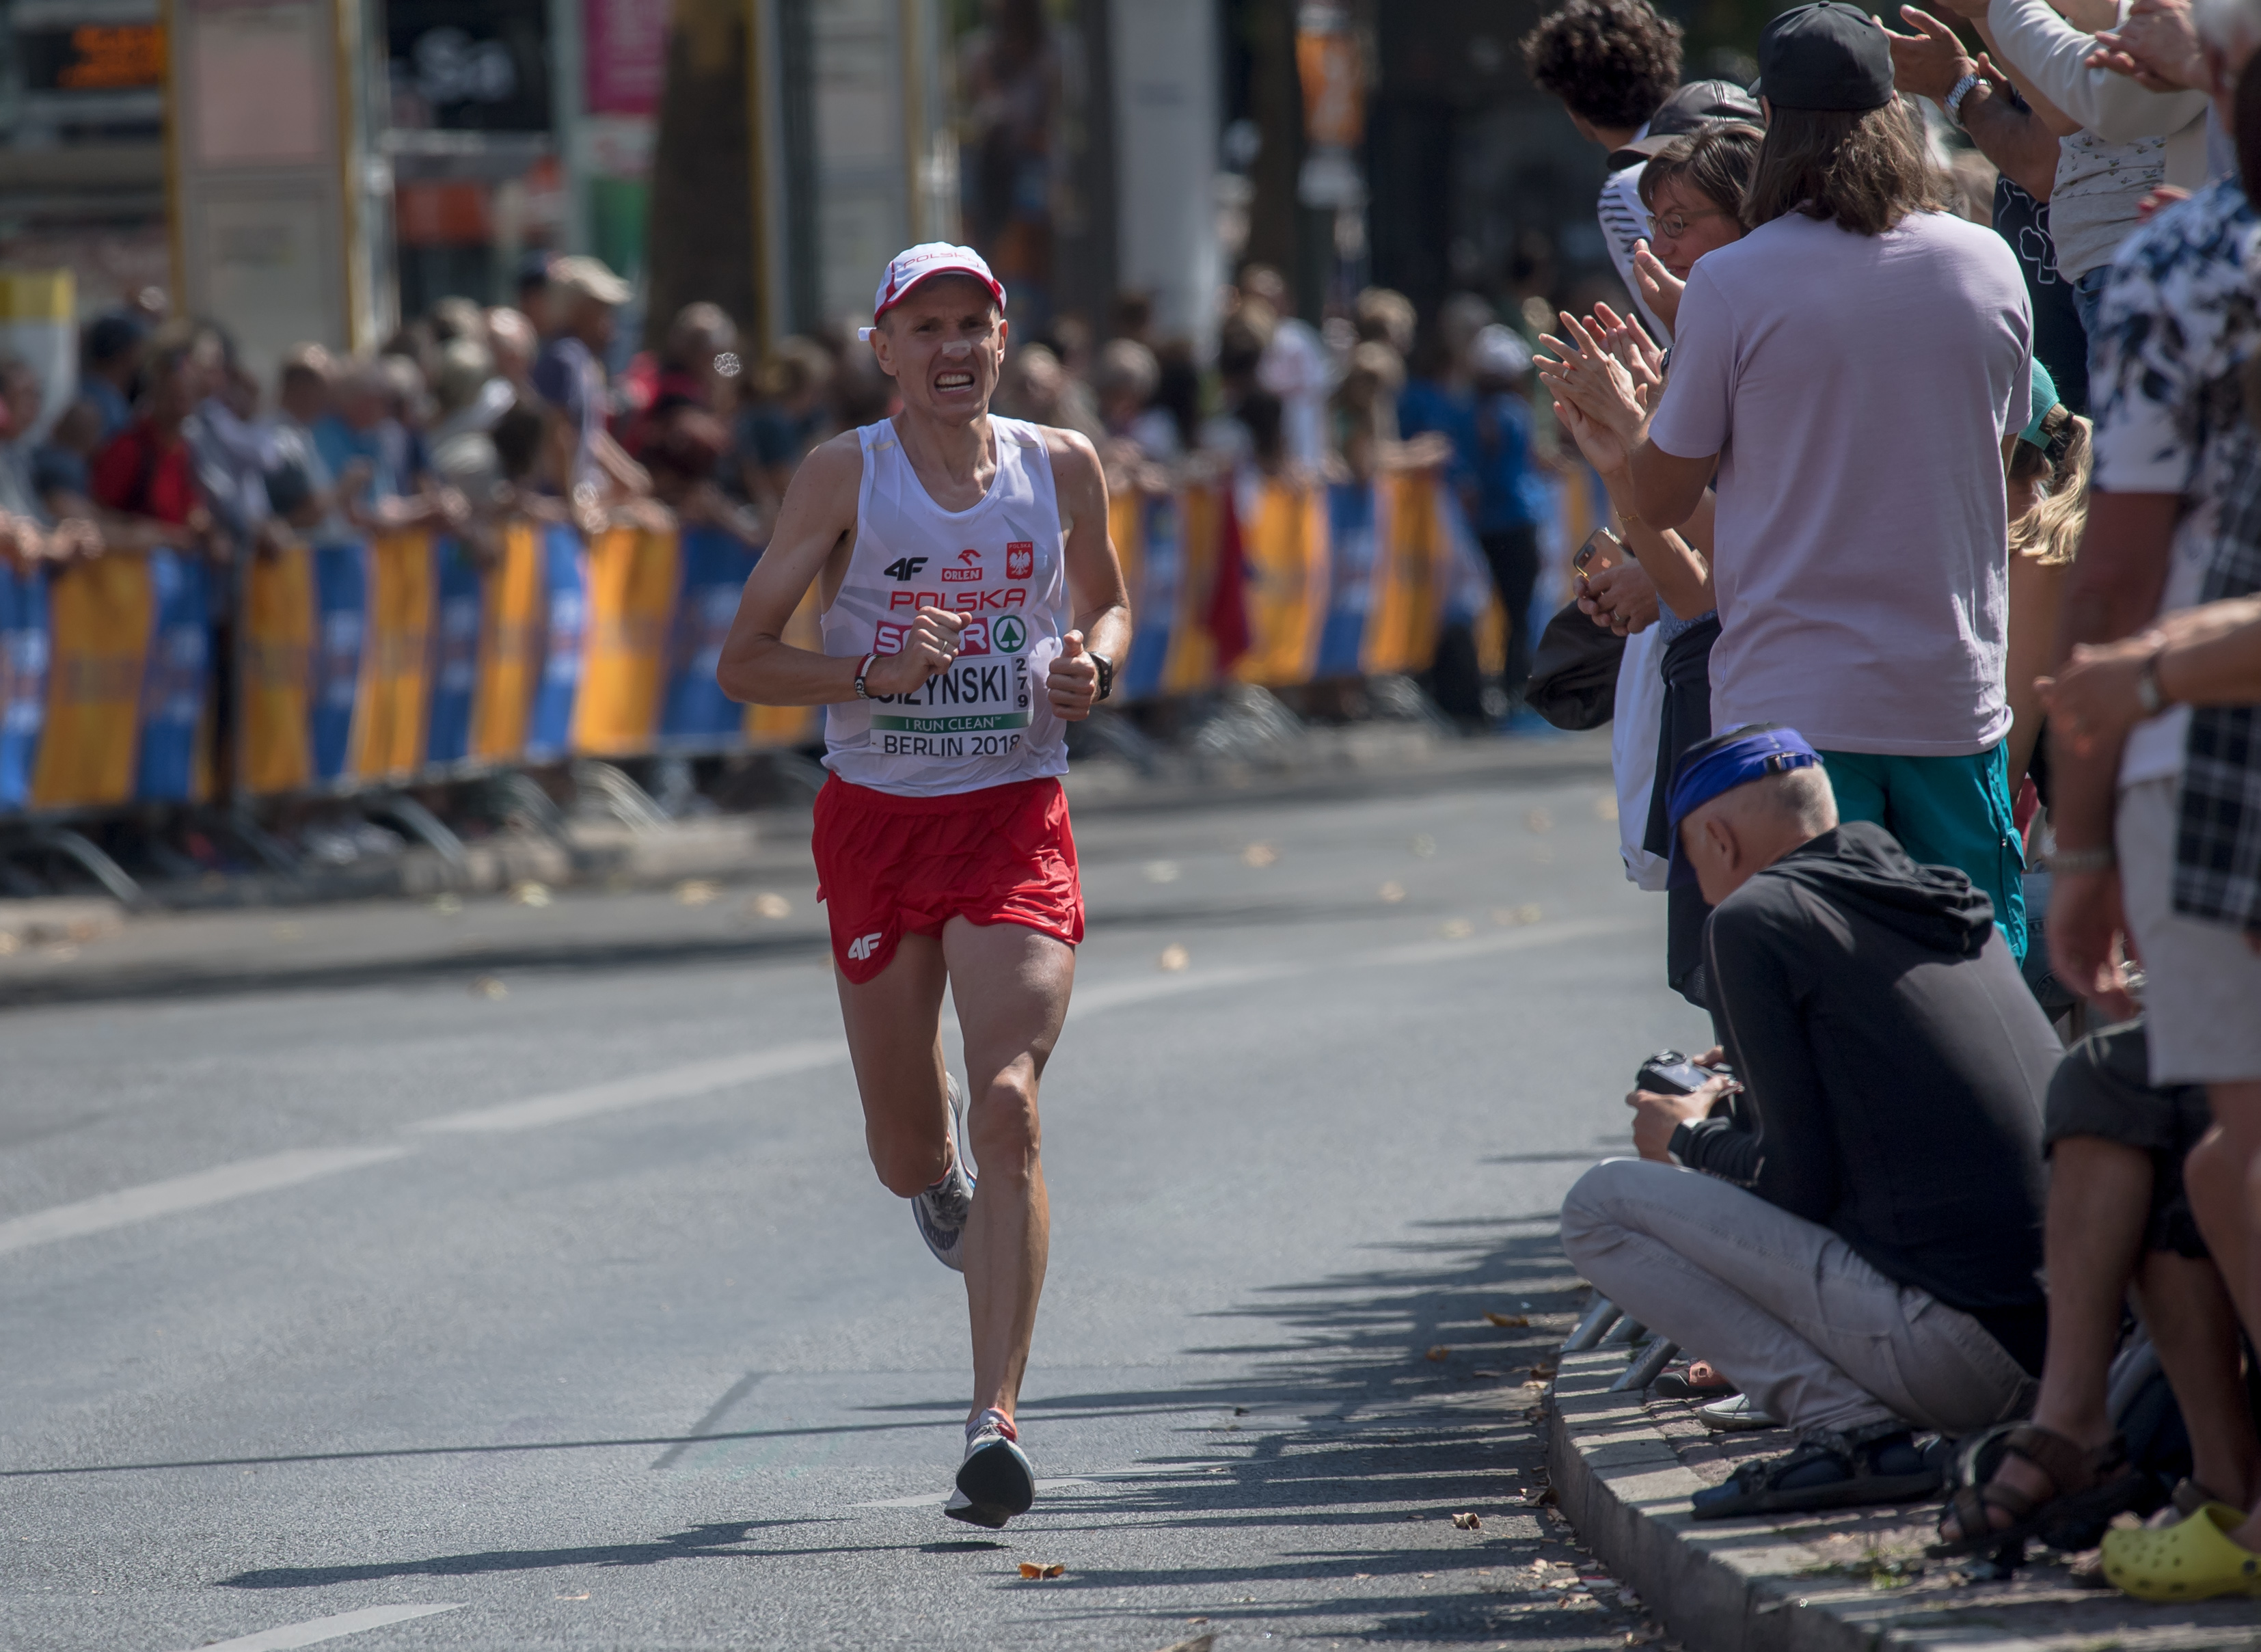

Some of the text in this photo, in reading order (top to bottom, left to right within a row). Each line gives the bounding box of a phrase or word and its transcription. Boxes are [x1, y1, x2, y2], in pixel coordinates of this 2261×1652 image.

[884, 557, 929, 581] 4F
[943, 569, 980, 580] ORLEN
[890, 588, 1027, 612] POLSKA
[876, 623, 988, 654] SR
[906, 719, 909, 729] I
[914, 720, 944, 731] RUN
[884, 735, 963, 757] BERLIN
[848, 932, 882, 960] 4F
